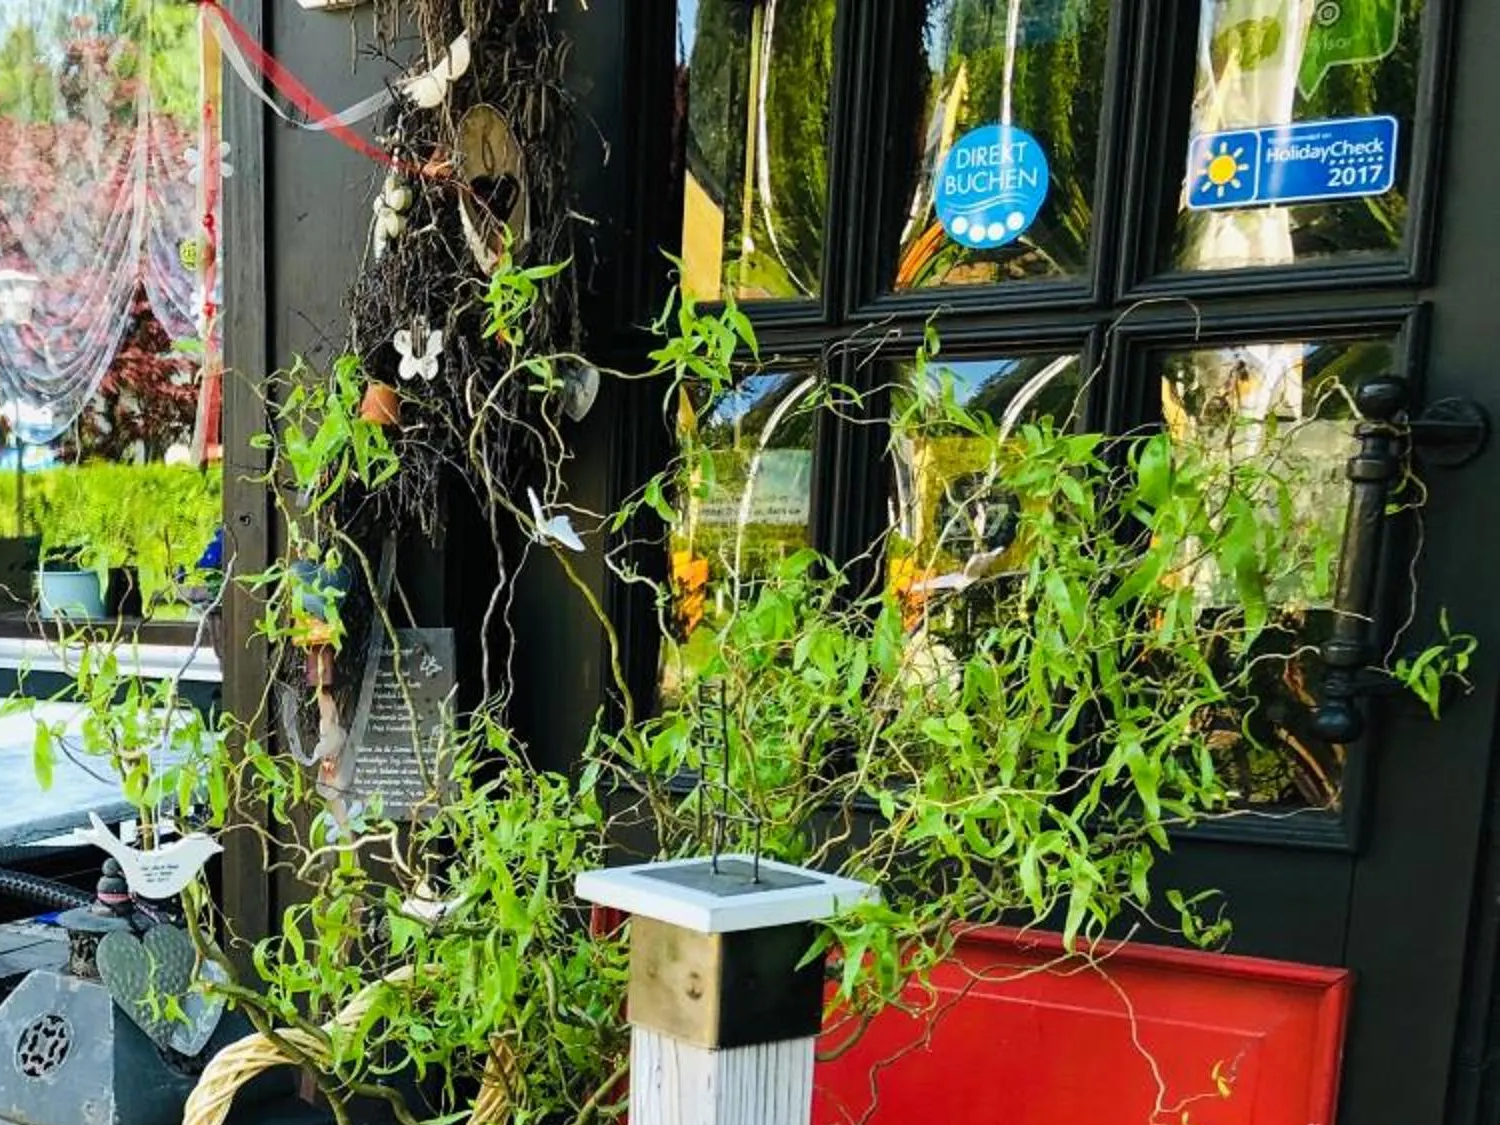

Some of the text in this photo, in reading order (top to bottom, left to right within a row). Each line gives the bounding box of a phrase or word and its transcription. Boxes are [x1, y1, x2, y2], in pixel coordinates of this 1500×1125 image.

[956, 140, 1028, 169] DIREKT
[1265, 137, 1385, 163] HolidayCheck
[944, 167, 1038, 195] BUCHEN
[1327, 164, 1383, 187] 2017
